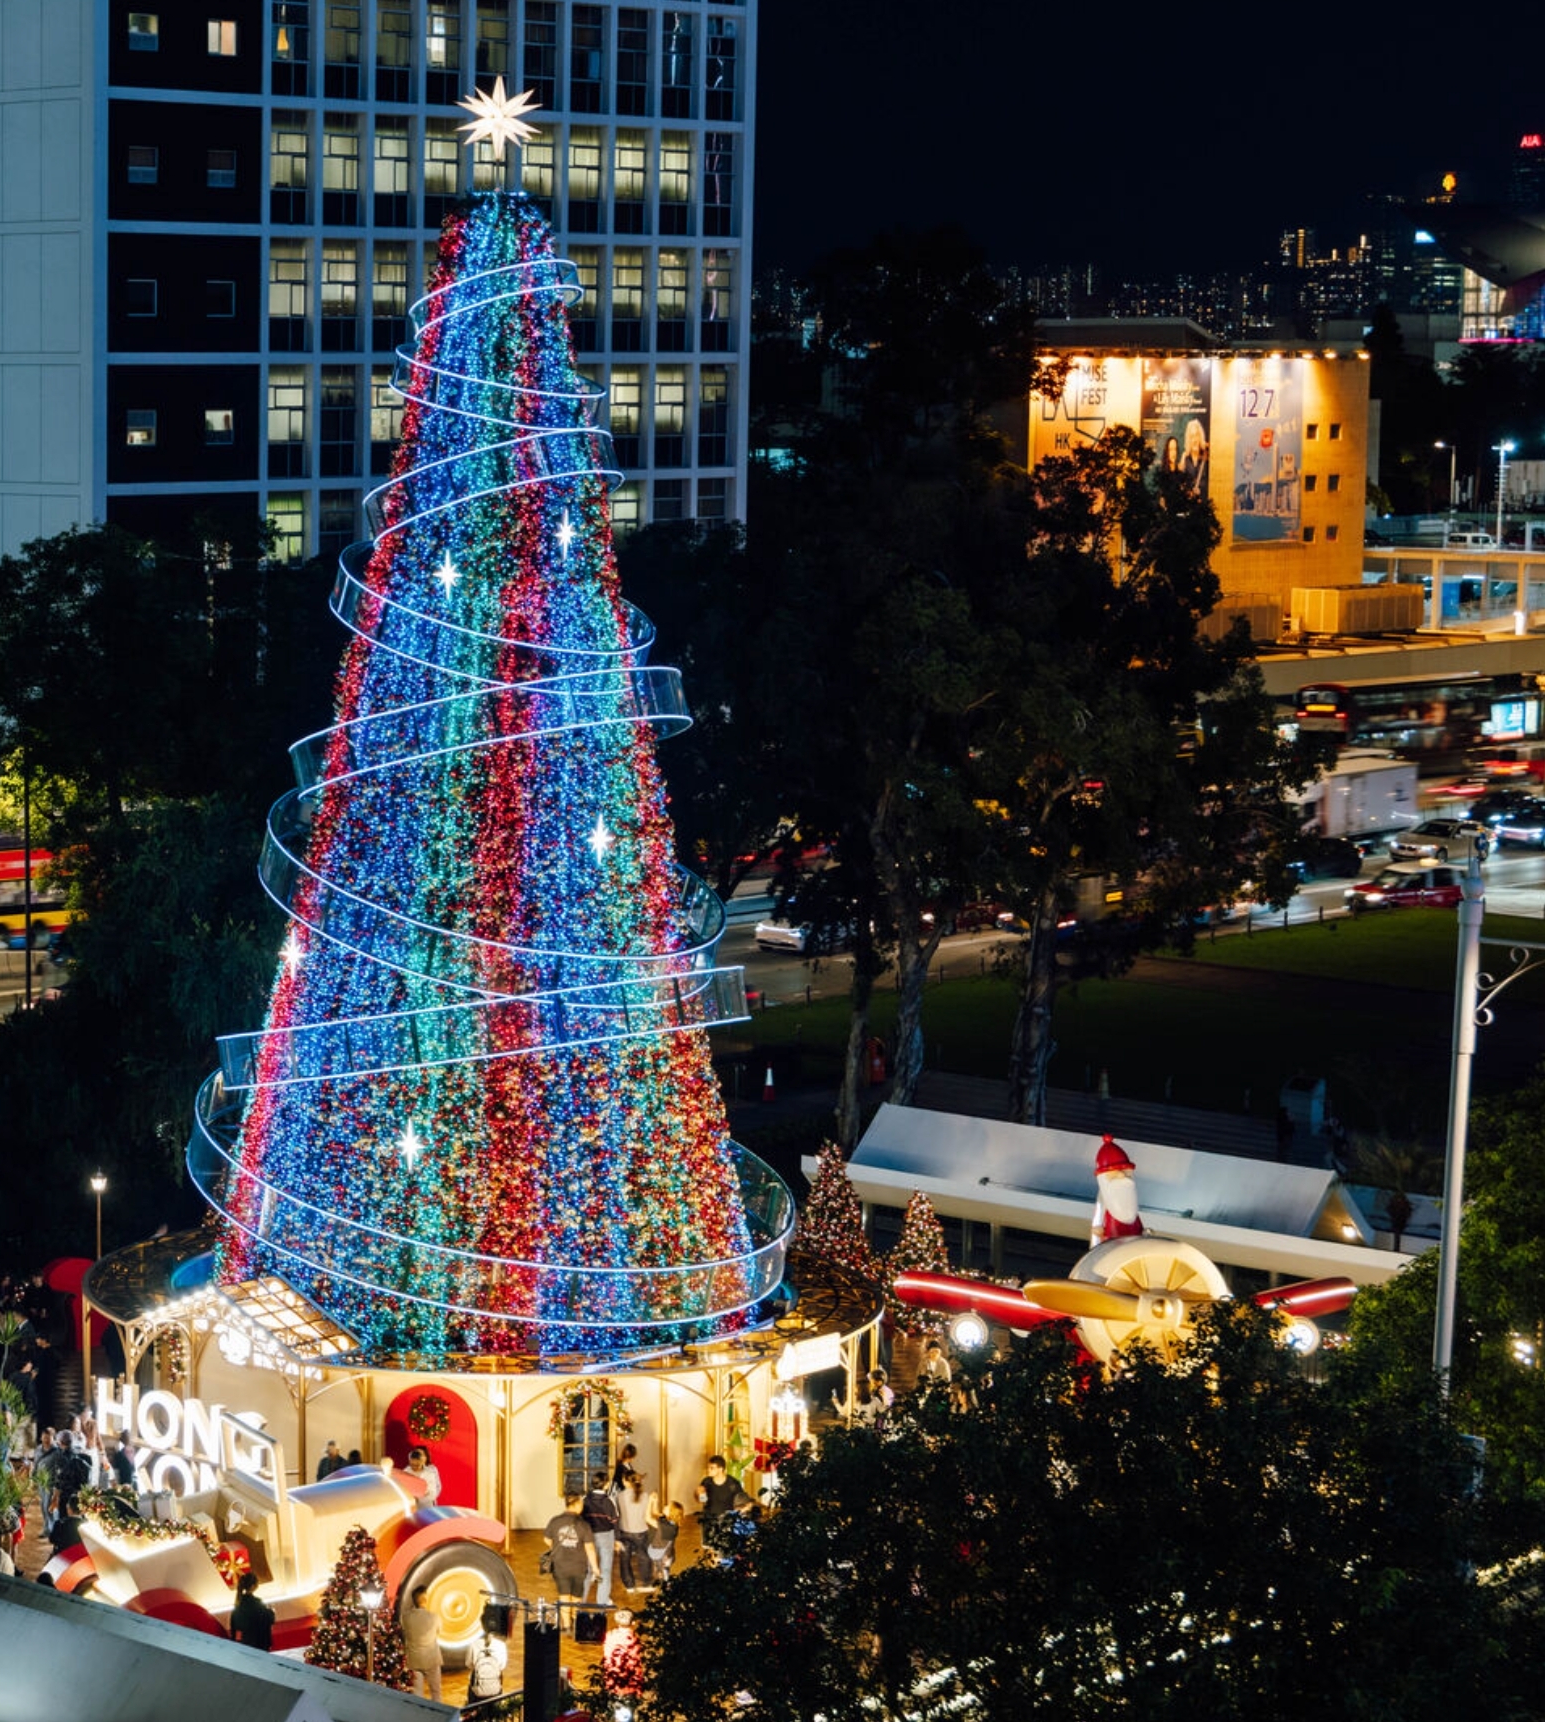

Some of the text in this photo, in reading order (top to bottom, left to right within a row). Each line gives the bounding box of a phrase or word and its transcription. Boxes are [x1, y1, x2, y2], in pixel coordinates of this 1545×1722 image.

[1520, 134, 1541, 148] AIA
[1081, 387, 1108, 405] FEST
[1055, 432, 1071, 449] HK
